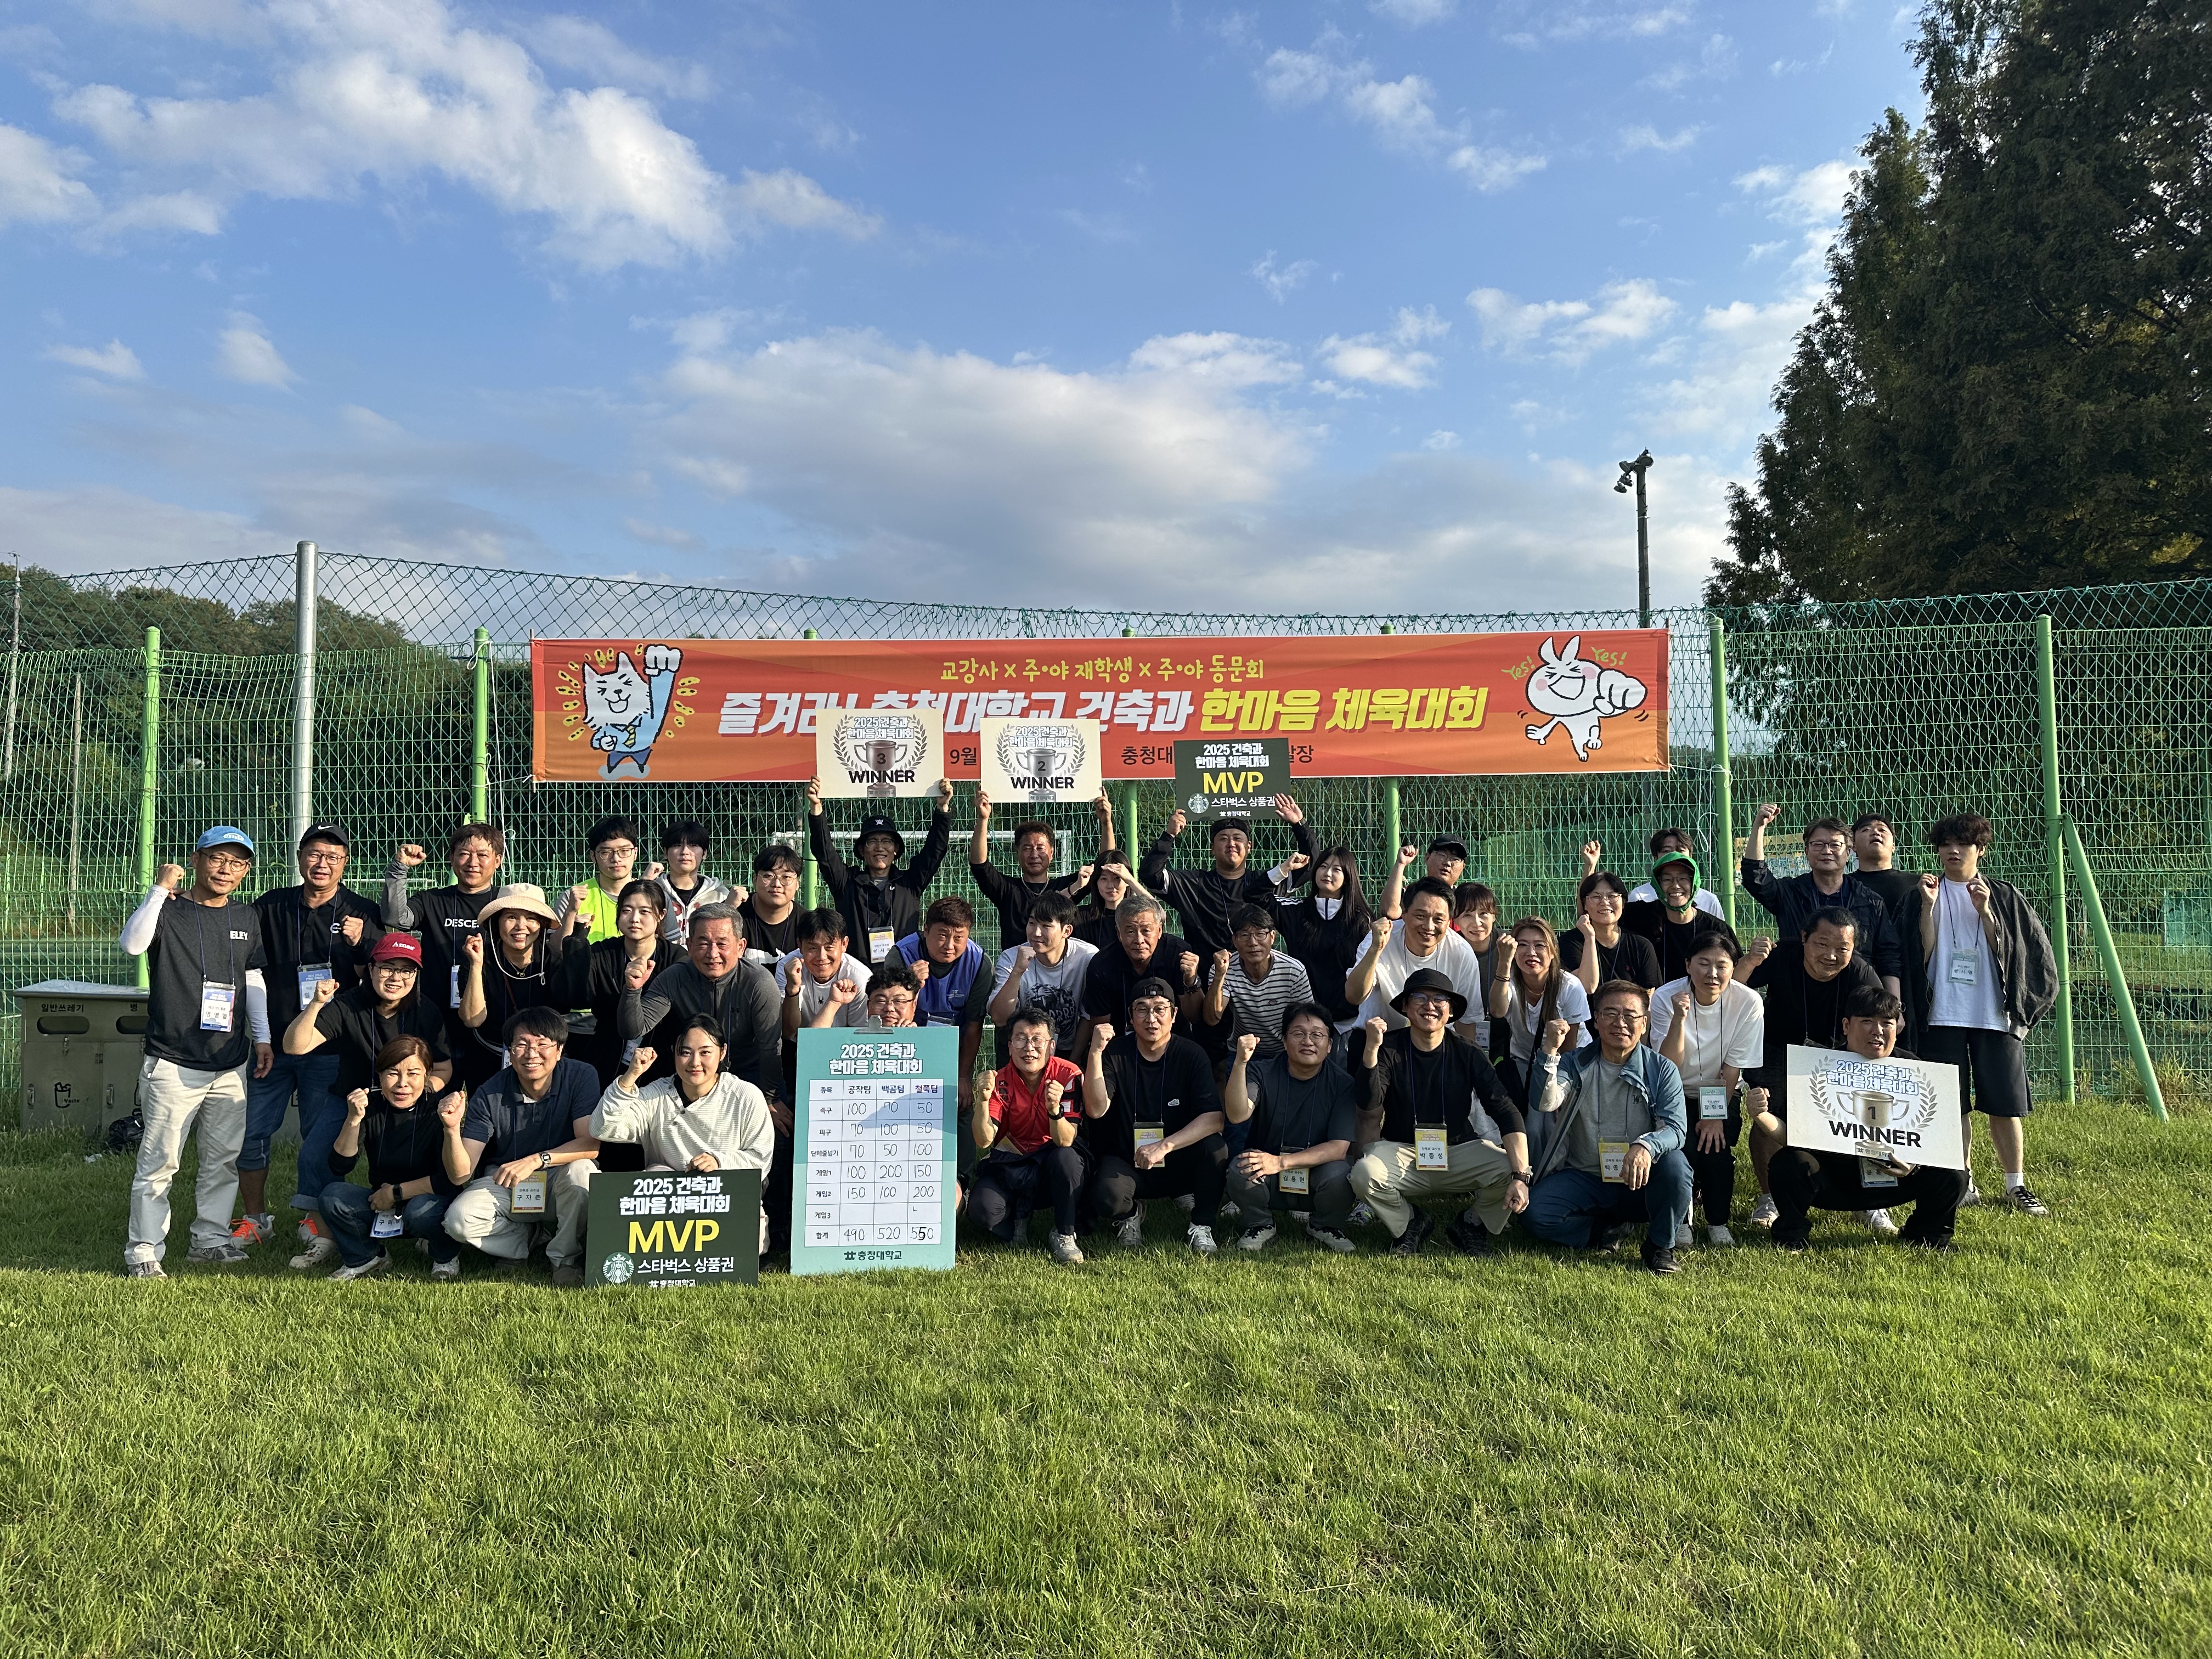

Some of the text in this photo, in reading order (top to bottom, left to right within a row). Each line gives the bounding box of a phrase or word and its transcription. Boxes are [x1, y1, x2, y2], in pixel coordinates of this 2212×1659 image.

[1592, 646, 1627, 666] Yes!
[941, 658, 998, 684] 교강사
[1075, 656, 1132, 683] 재학생
[1209, 654, 1264, 683] 동문회
[1502, 657, 1535, 680] Yes!
[1076, 689, 1194, 732] 건축과
[1200, 688, 1321, 731] 한마음
[1325, 685, 1489, 731] 체육대회
[854, 716, 909, 729] 2025 건축과
[847, 728, 915, 740] 한마음 체육대회
[1015, 726, 1068, 737] 2025 건축과
[1008, 737, 1074, 748] 한마음 체육대회
[1204, 743, 1263, 755] 2025 건축과
[877, 753, 886, 765] 3
[950, 747, 978, 766] 9월
[1195, 755, 1269, 769] 한마음 체육대회
[1038, 761, 1046, 772] 2
[848, 770, 916, 783] WINNER
[1011, 777, 1074, 789] WINNER
[1203, 771, 1263, 794] MVP
[1211, 796, 1276, 808] 스타벅스 상품권
[444, 918, 480, 928] DESCE
[41, 1003, 138, 1013] 일반쓰레기 병
[840, 1042, 917, 1059] 2025 건축과
[830, 1058, 923, 1075] 한마음 체육대회
[1837, 1059, 1911, 1082] 2025 건축과
[848, 1085, 871, 1094] 공작팀
[882, 1085, 905, 1094] 백곰팀
[915, 1084, 938, 1093] 철쭉팀
[1826, 1070, 1919, 1096] 한마음 체육대회
[847, 1102, 933, 1115] 100 70 50
[1867, 1106, 1876, 1120] 1
[850, 1122, 933, 1137] 70 100 50
[1828, 1120, 1922, 1148] WINNER
[850, 1143, 932, 1159] 70 50 100
[847, 1164, 932, 1180] 100 200 150
[633, 1176, 723, 1195] 2025 건축과
[848, 1186, 934, 1199] 150 100 200
[619, 1194, 730, 1215] 한마음 체육대회
[628, 1220, 720, 1254] MVP
[844, 1227, 934, 1242] 490 520 550
[857, 1250, 902, 1260] 충청대학교
[637, 1257, 734, 1274] 스타벅스 상품권
